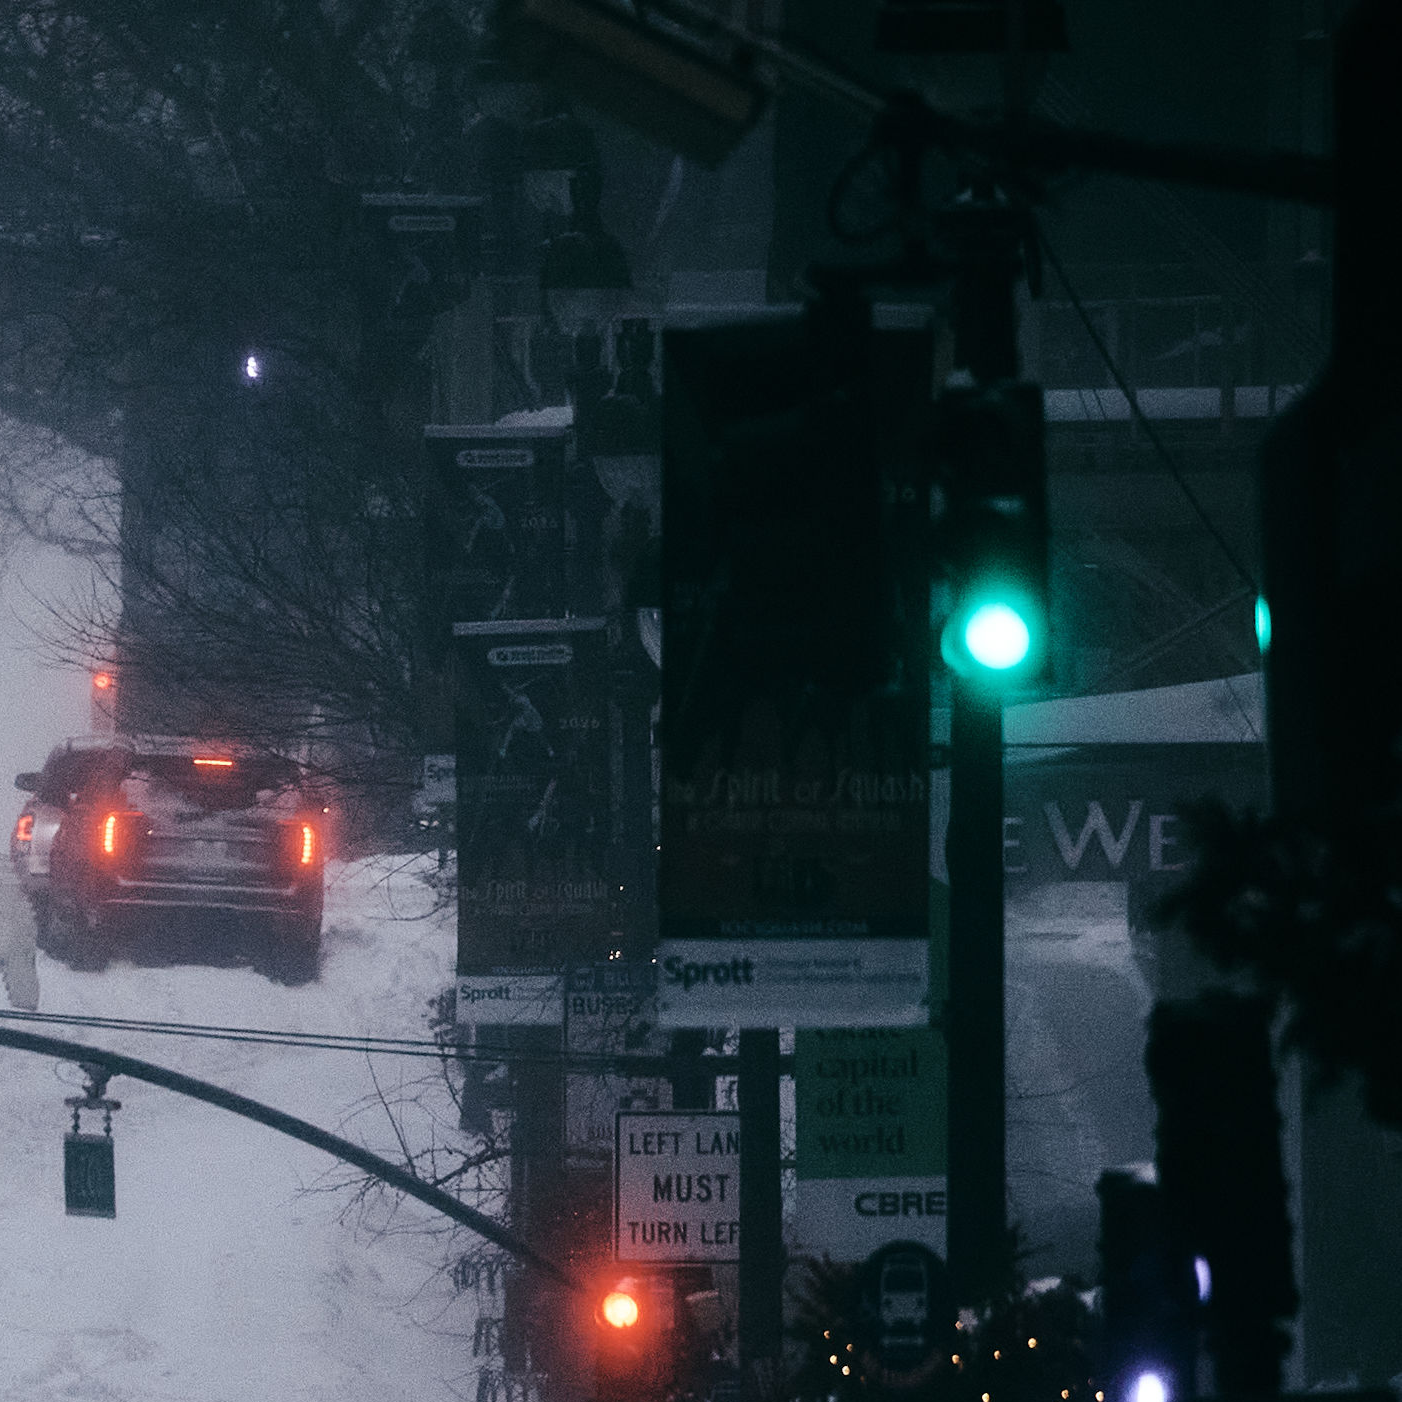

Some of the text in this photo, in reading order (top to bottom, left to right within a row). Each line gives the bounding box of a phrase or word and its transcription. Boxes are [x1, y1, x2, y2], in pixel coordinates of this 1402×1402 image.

[704, 768, 782, 809] Spirit
[830, 769, 927, 809] Squash
[664, 956, 754, 990] Sprott
[460, 984, 511, 1003] Sprott
[816, 1049, 919, 1084] capital
[816, 1087, 901, 1116] of the
[628, 1132, 741, 1156] LEFT LAN
[816, 1125, 906, 1156] world
[652, 1176, 730, 1204] MUST
[855, 1192, 947, 1217] CBRE
[628, 1221, 741, 1246] TURN LEF
